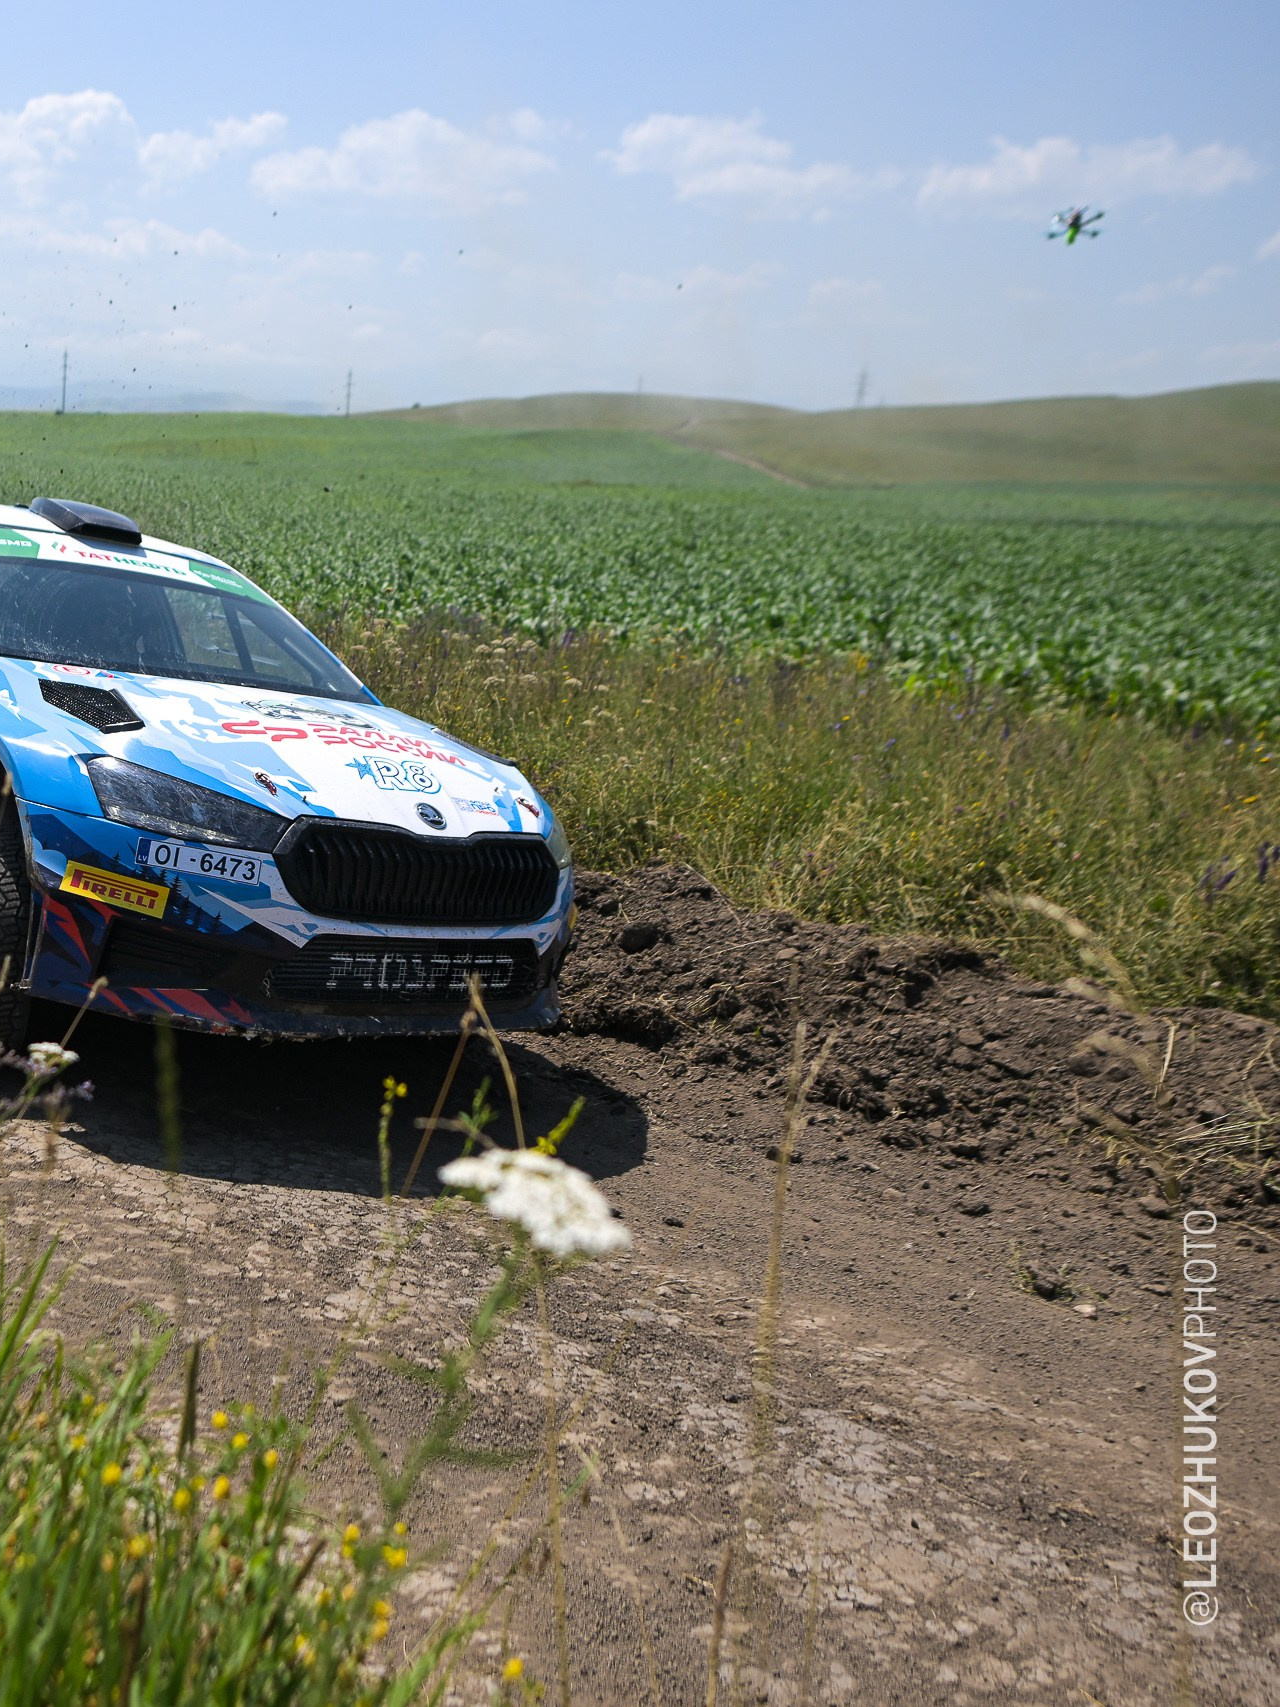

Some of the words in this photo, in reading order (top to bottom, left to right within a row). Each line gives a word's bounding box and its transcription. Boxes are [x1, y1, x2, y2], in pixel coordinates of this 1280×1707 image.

[74, 550, 187, 576] ТАТНЕФТЬ
[307, 723, 432, 750] РАЛЛИ
[317, 734, 466, 767] РОССИИ
[137, 854, 148, 863] LV
[70, 868, 160, 910] PIRELLI
